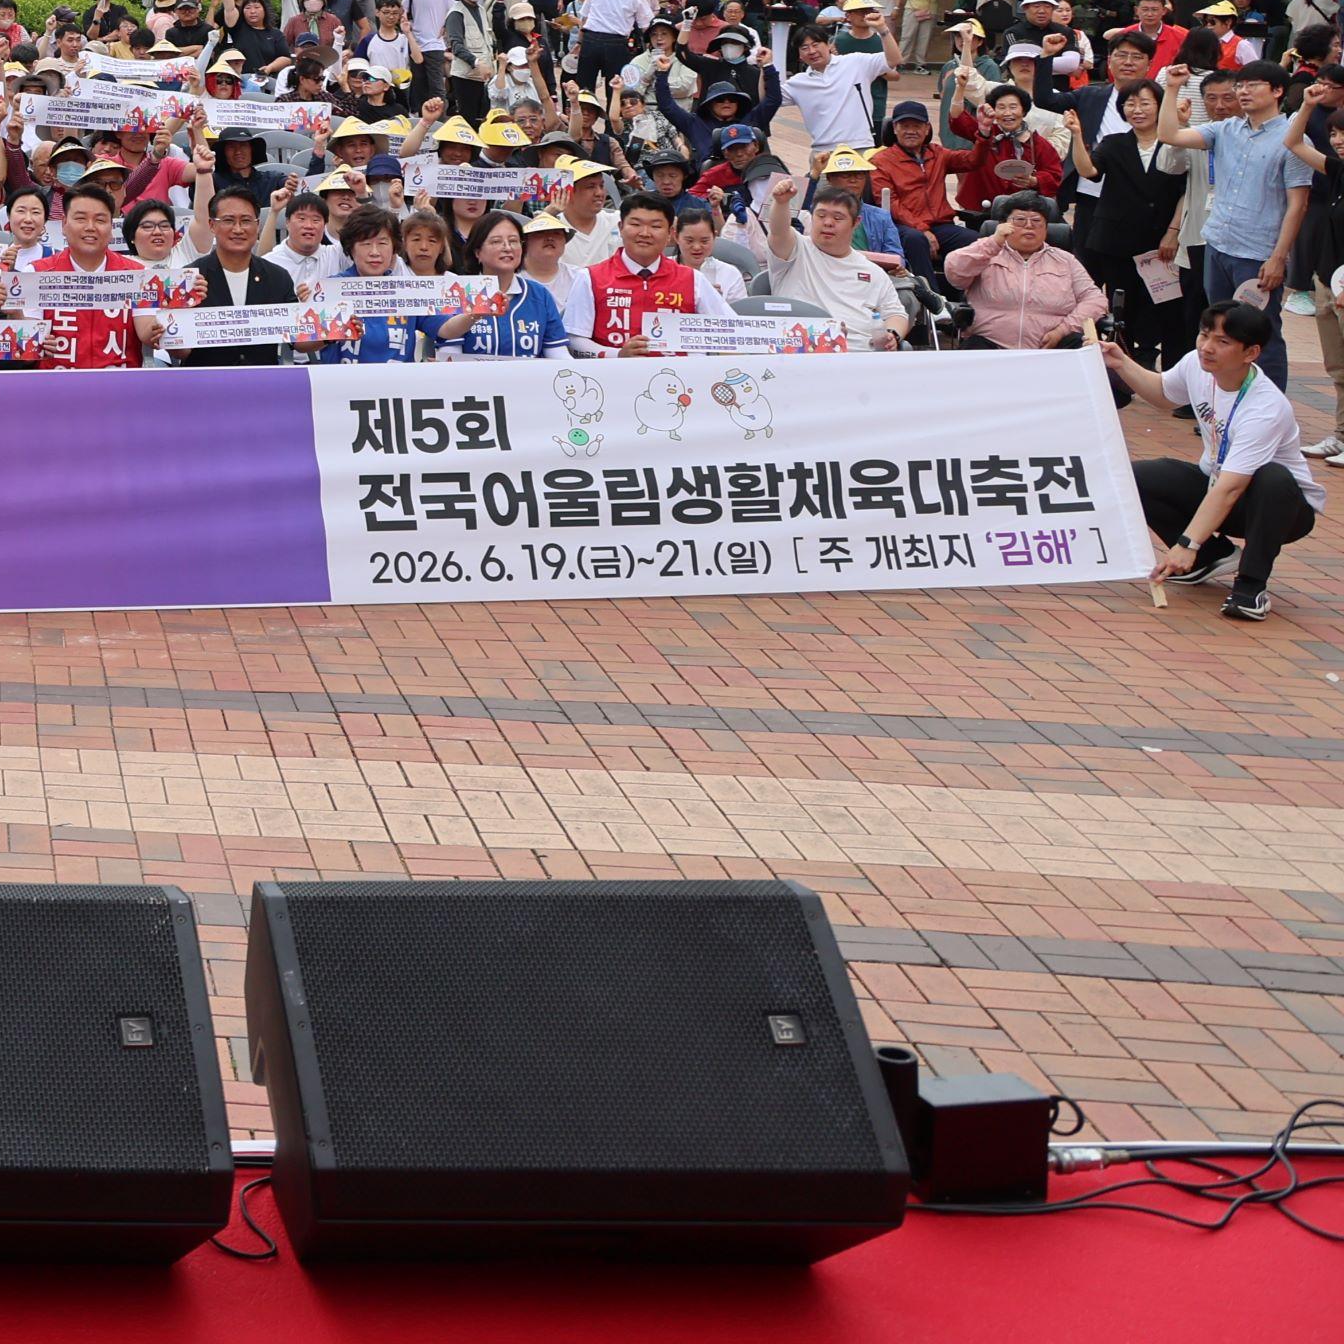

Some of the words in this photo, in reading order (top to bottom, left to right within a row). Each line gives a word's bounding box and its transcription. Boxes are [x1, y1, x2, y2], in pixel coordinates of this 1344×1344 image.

[67, 101, 121, 110] 전국생활체육대축전
[438, 168, 458, 177] 2026
[458, 169, 518, 179] 전국생활체육대축전
[39, 275, 62, 284] 2026
[63, 274, 134, 284] 전국생활체육대축전
[341, 281, 363, 290] 2026
[365, 280, 435, 290] 전국생활체육대축전
[62, 291, 158, 302] 전국어울림생활체육대축전
[606, 296, 632, 308] 김해
[654, 291, 684, 307] 2-가
[365, 298, 460, 308] 전국어울림생활체육대축전
[194, 312, 217, 320] 2026
[218, 308, 289, 320] 전국생활체육대축전
[680, 318, 702, 328] 2026
[703, 318, 776, 330] 전국생활체육대축전
[219, 324, 315, 338] 전국어울림생활체육대축전
[704, 335, 803, 347] 전국어울림생활체육대축전
[349, 395, 513, 455] 제5회
[358, 454, 1096, 533] 전국어울림생활체육대축전
[865, 532, 977, 573] 개최지
